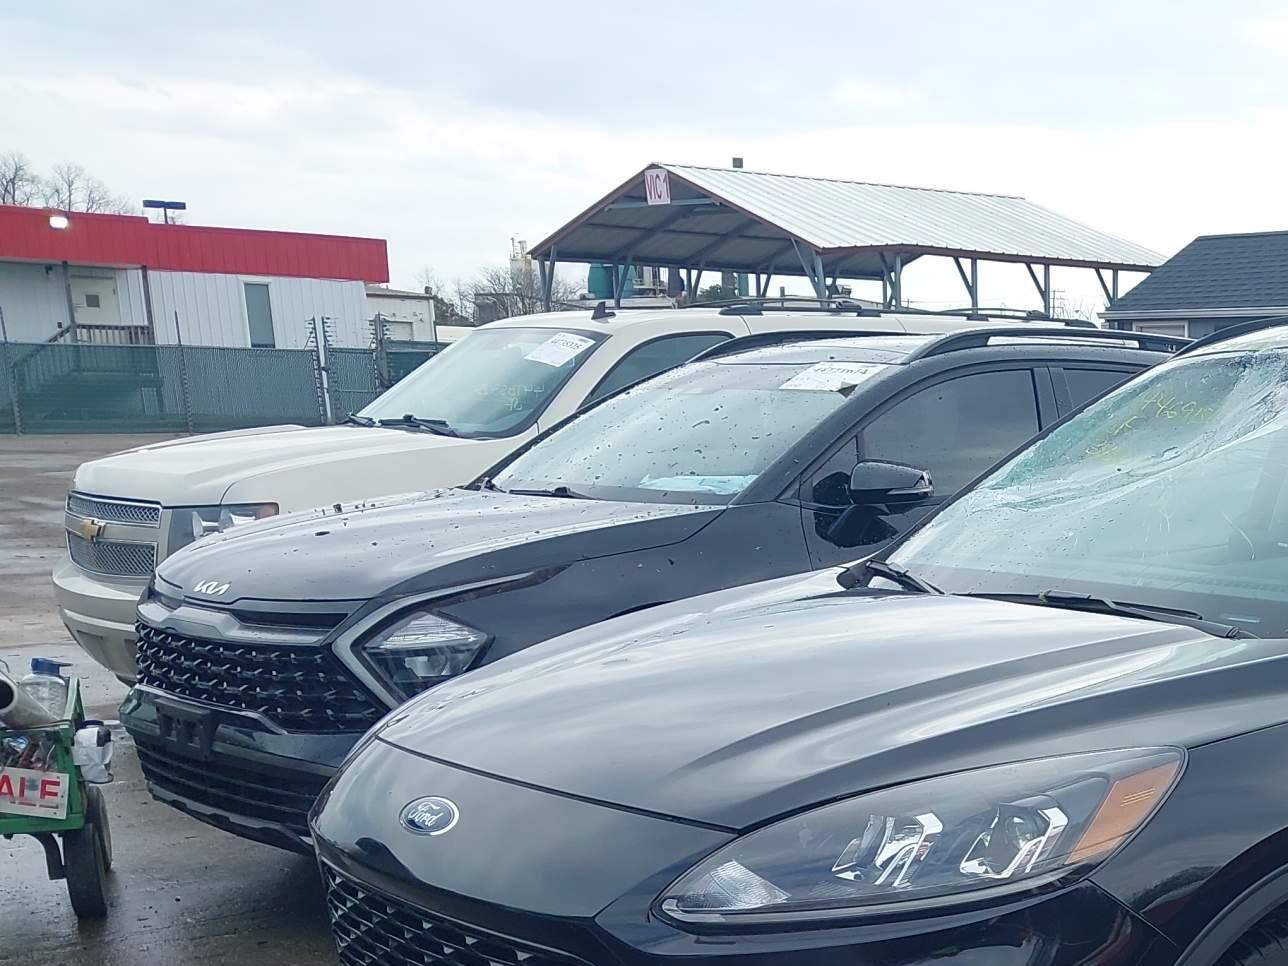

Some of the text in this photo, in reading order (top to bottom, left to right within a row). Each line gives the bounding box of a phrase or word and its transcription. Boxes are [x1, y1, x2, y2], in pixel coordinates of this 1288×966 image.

[645, 173, 670, 200] VIC 1
[408, 801, 444, 827] Ford
